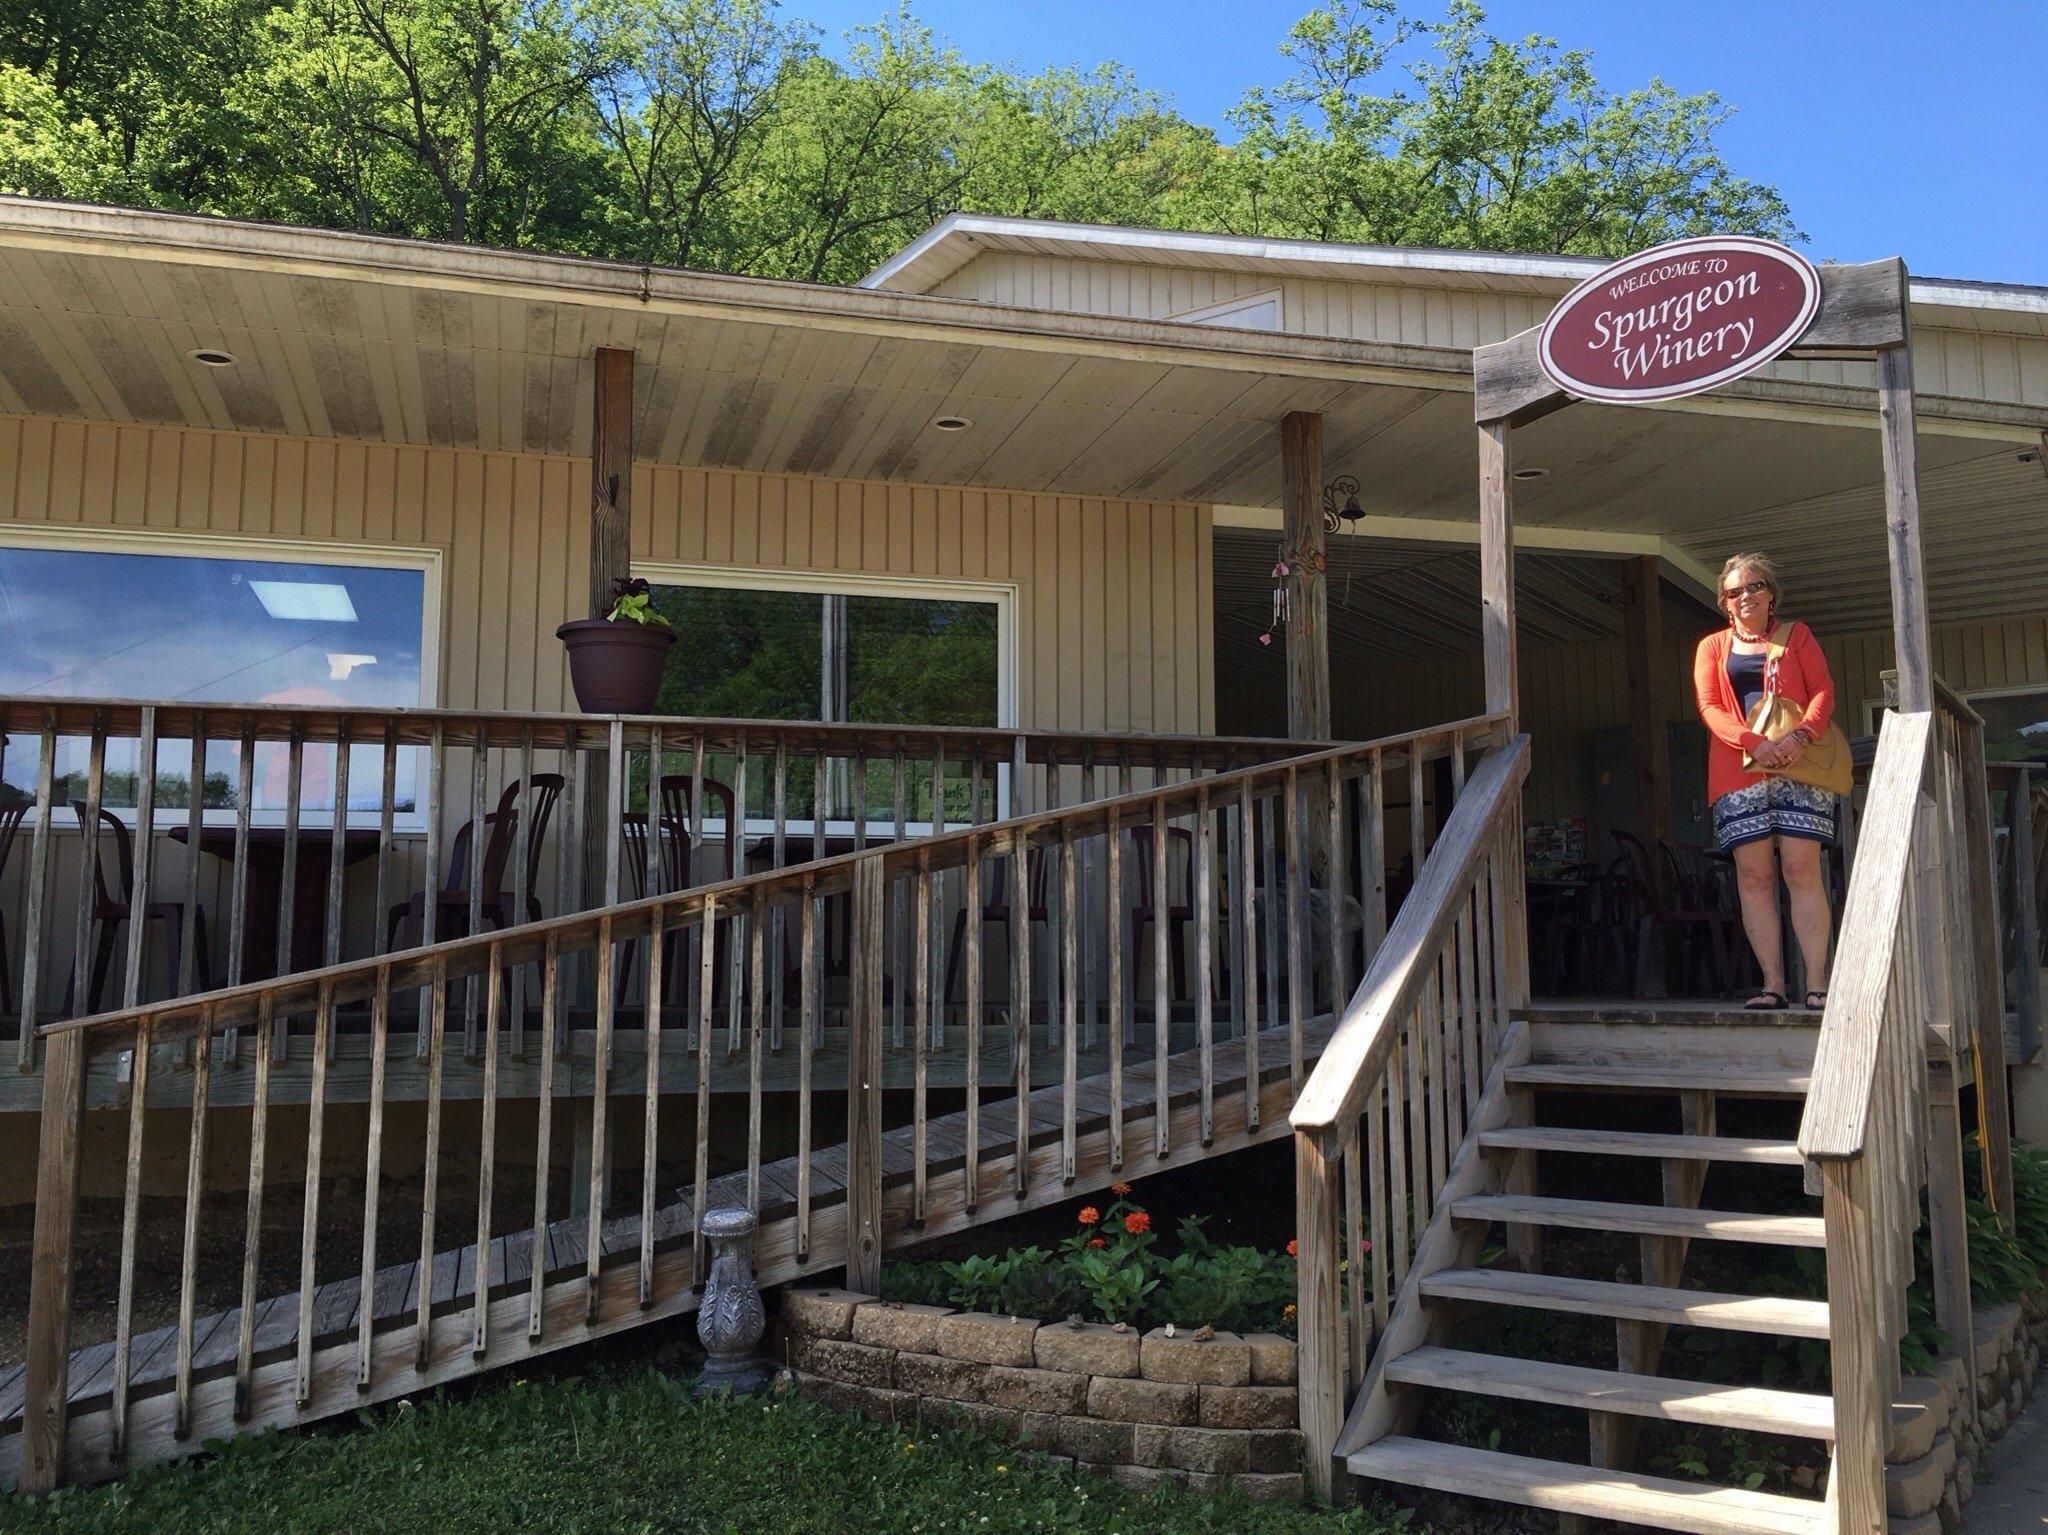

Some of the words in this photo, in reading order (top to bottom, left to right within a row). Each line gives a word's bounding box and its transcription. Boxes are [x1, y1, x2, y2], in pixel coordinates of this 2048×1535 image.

[1609, 261, 1700, 300] WELCOME
[1704, 258, 1728, 274] TO
[1588, 271, 1761, 352] Spurgeon
[1613, 317, 1754, 381] Winery
[924, 781, 964, 799] Tank
